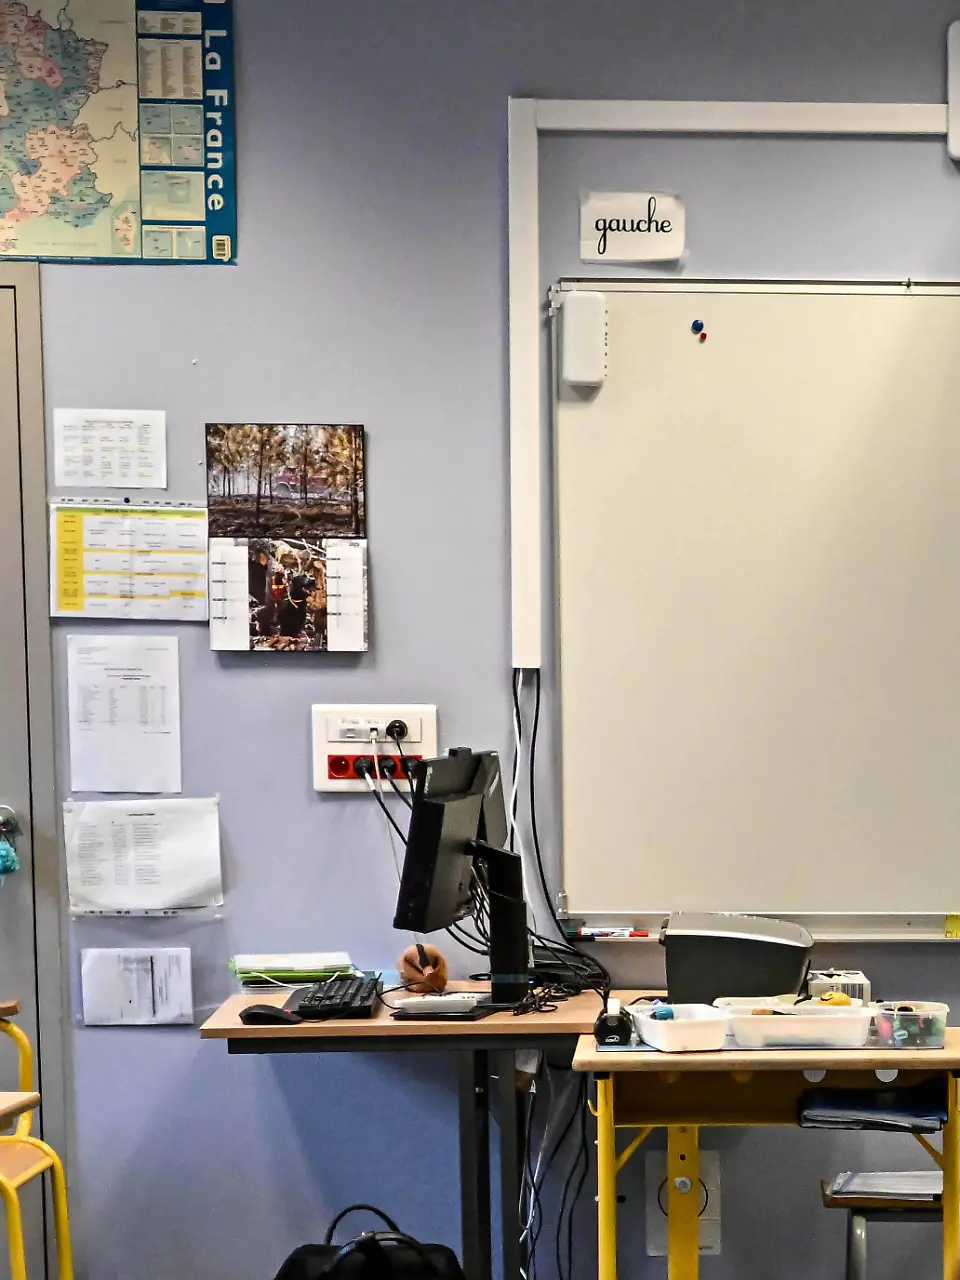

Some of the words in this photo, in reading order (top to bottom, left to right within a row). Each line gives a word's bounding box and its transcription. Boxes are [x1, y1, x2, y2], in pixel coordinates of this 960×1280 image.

[204, 29, 227, 71] La
[206, 89, 229, 211] France
[594, 196, 673, 255] gauche
